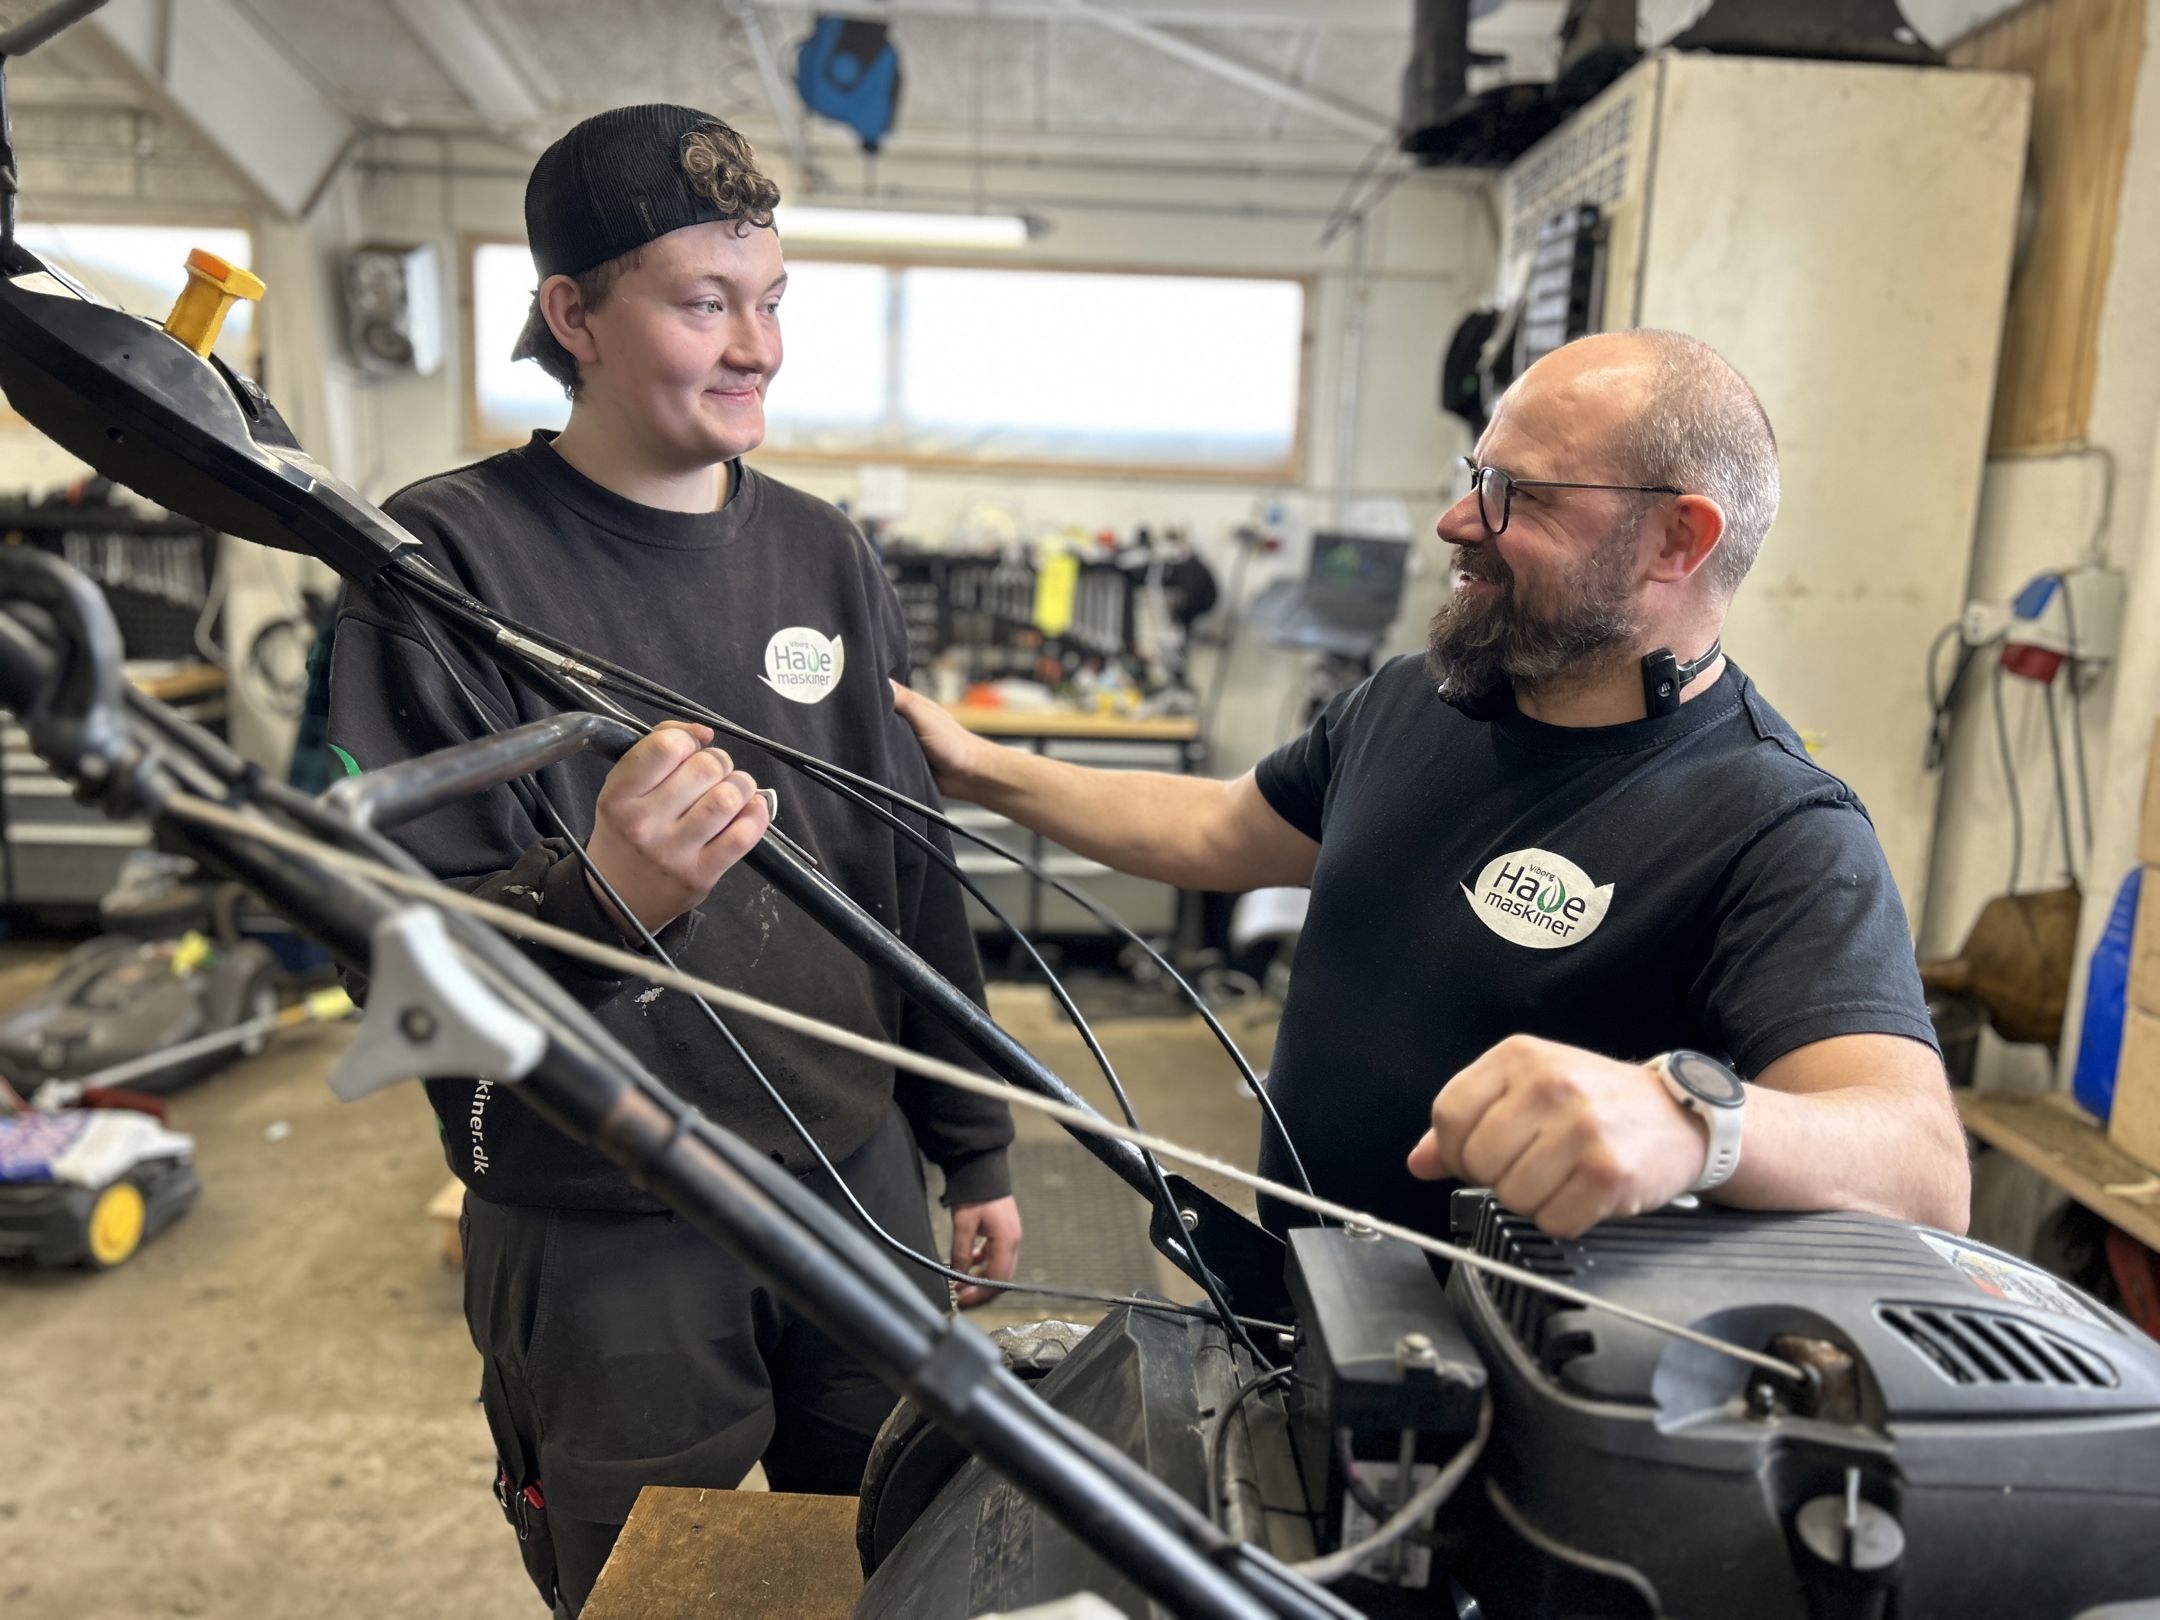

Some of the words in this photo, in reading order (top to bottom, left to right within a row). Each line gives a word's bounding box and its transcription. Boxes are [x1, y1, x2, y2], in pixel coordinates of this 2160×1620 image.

[777, 672, 831, 686] maskiner
[1529, 864, 1556, 882] Viborg
[1484, 891, 1575, 938] maskiner
[470, 1076, 494, 1175] kiner.dk
